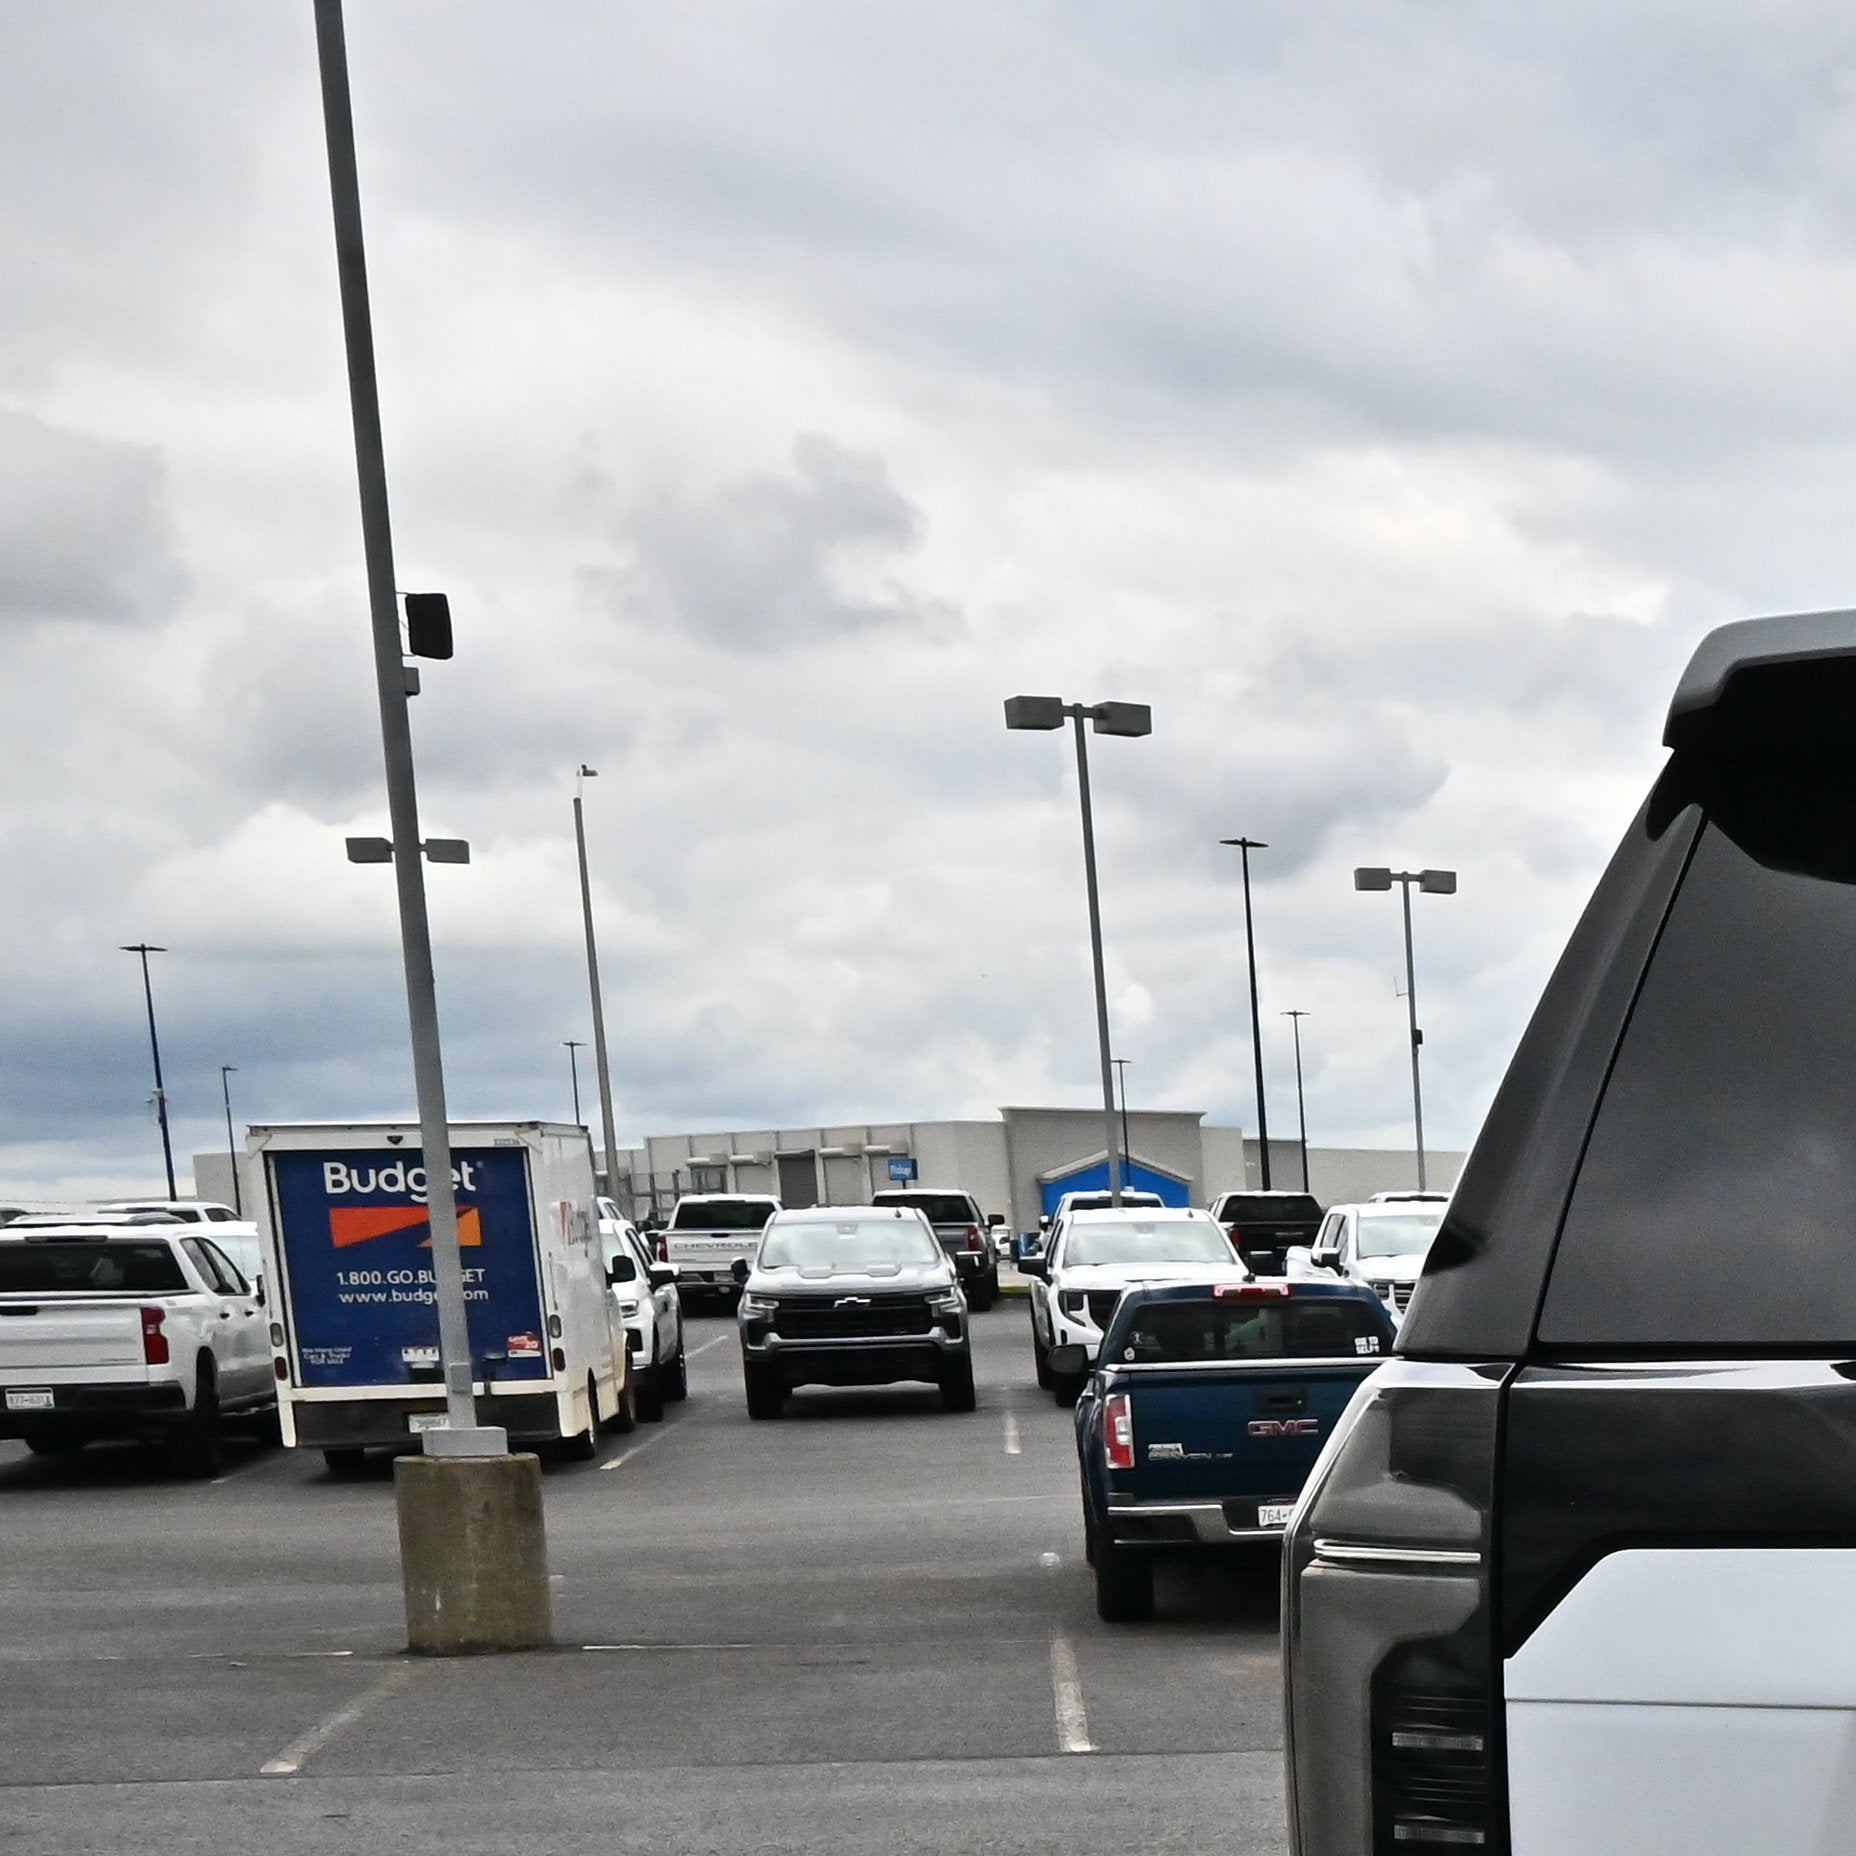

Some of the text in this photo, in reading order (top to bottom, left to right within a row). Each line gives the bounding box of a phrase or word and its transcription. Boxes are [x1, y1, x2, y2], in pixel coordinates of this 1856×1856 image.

[673, 1241, 759, 1251] CHEVROLE
[336, 1268, 486, 1285] 1.800.GO.BUET
[338, 1288, 489, 1305] www.budgom
[1247, 1418, 1319, 1436] GMC
